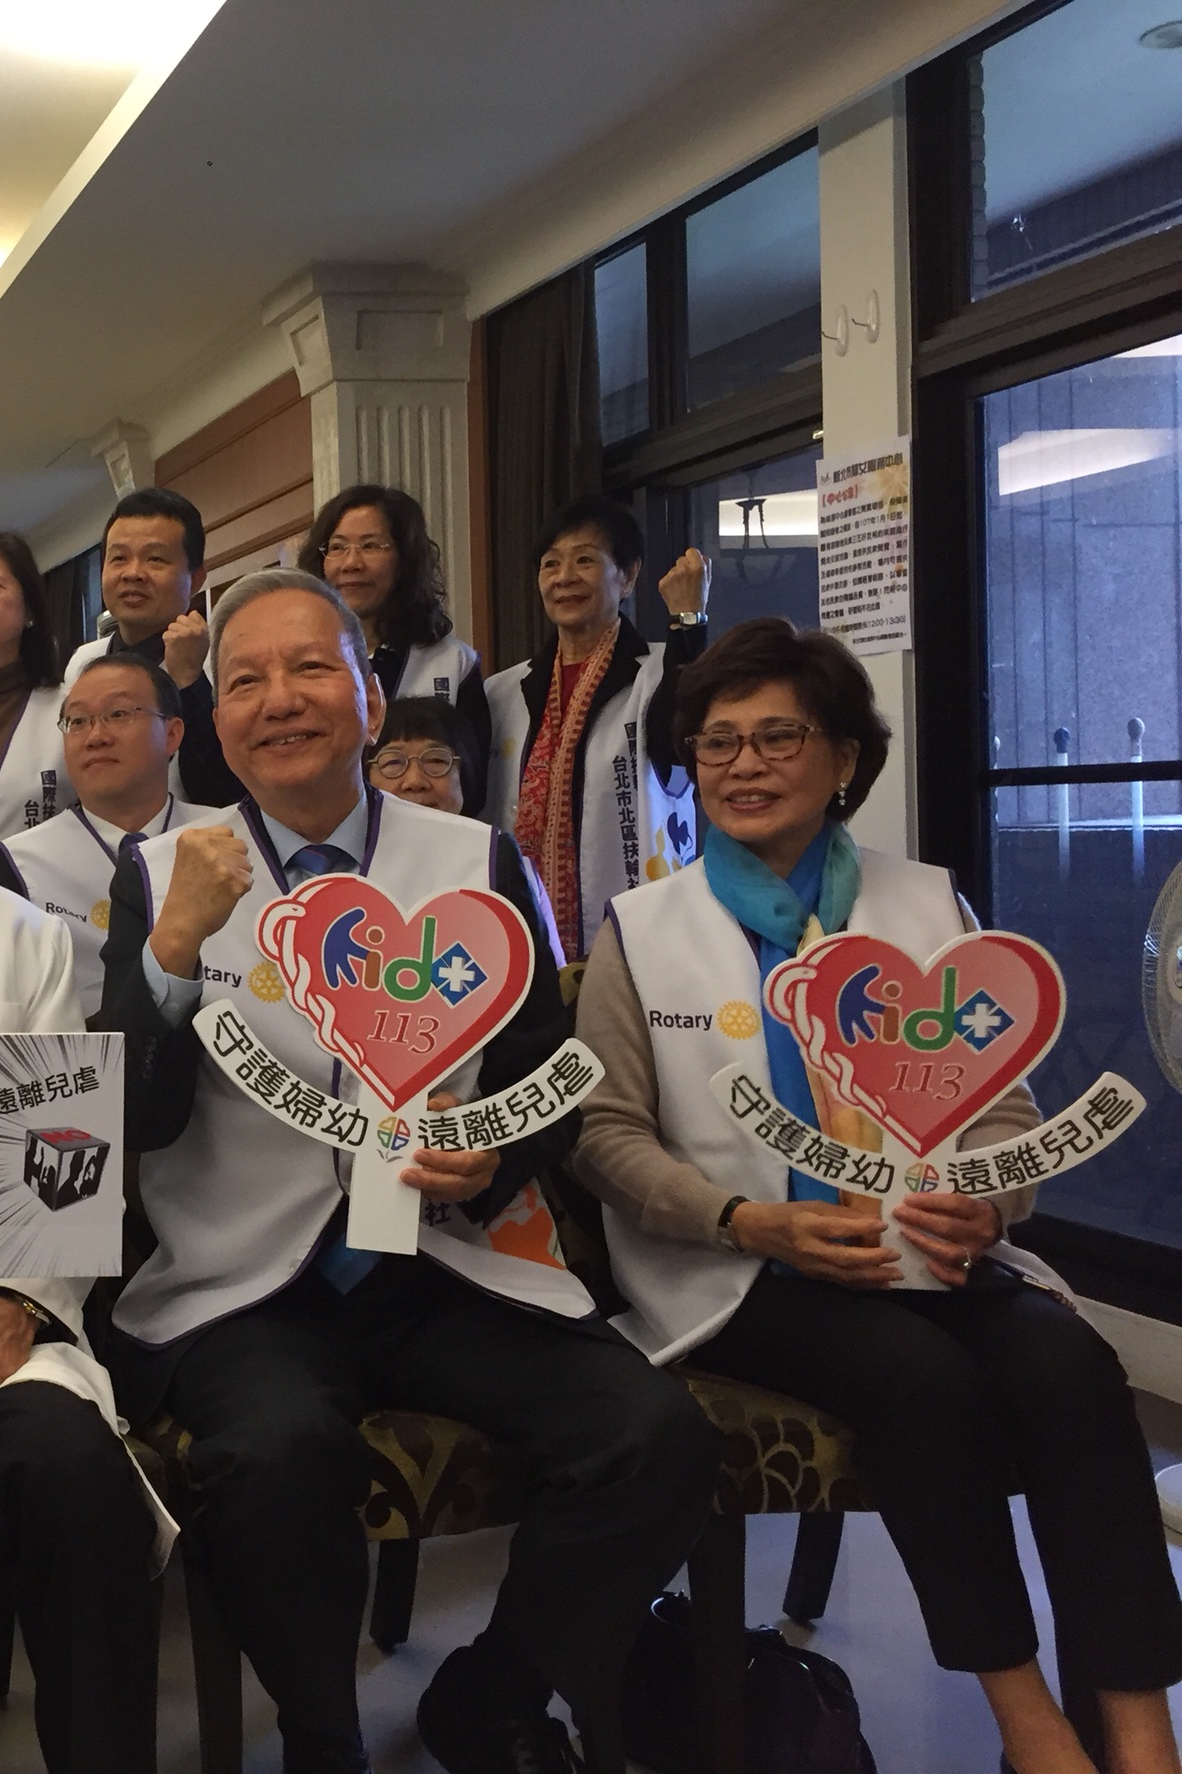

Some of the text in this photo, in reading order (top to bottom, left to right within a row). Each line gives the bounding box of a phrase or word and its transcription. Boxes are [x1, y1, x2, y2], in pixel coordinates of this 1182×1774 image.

[204, 965, 242, 988] tary
[367, 1010, 440, 1053] 113
[649, 1010, 713, 1032] Rotary
[213, 1010, 369, 1147] 守護婦幼
[418, 1051, 593, 1152] 遠離兒虐
[889, 1061, 965, 1101] 113
[728, 1074, 895, 1194] 守護婦幼
[947, 1086, 1133, 1197] 遠離兒虐
